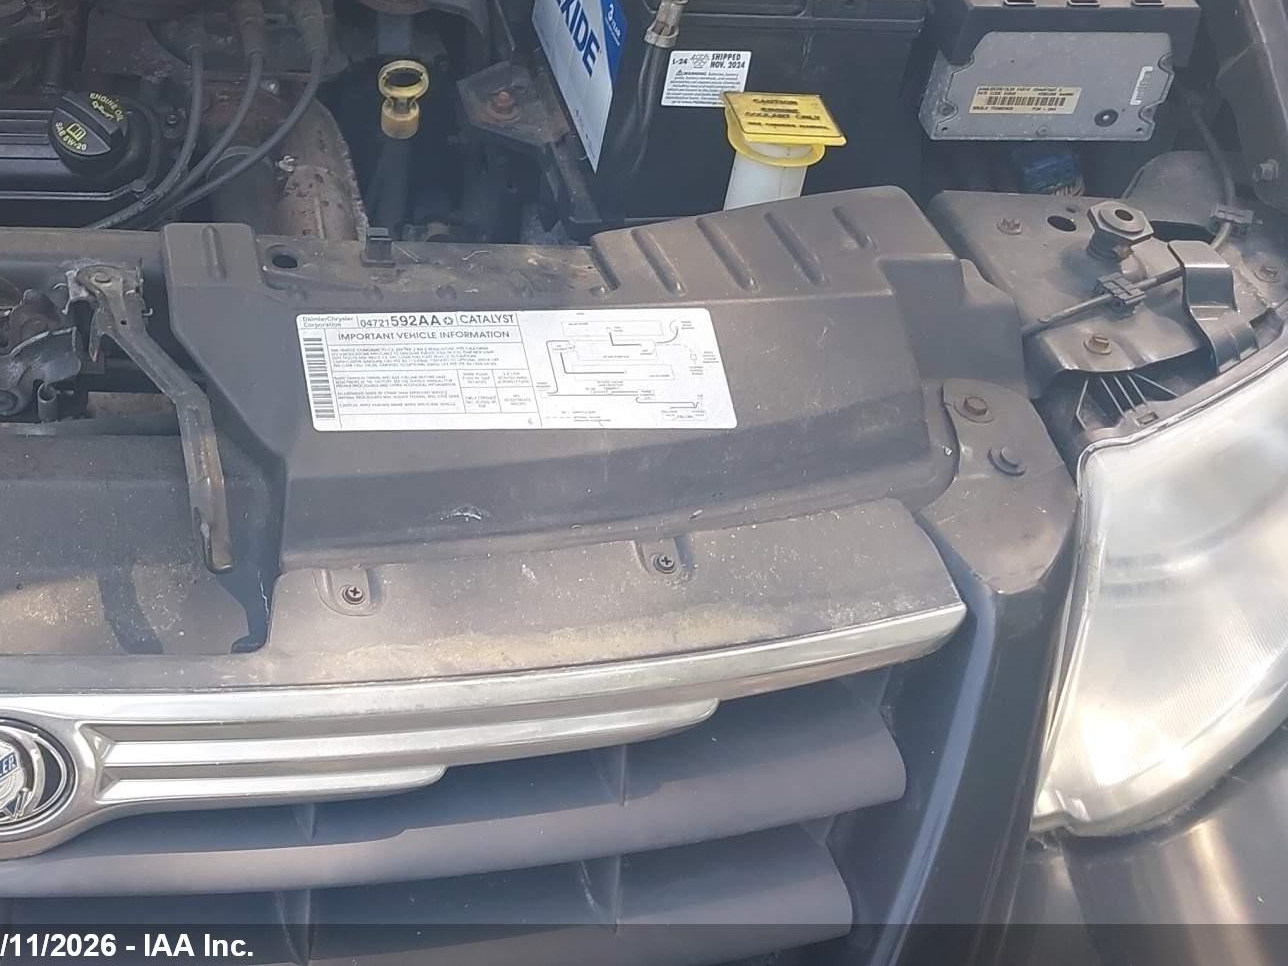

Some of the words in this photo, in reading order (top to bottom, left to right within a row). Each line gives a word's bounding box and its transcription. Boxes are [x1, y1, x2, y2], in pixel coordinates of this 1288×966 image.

[712, 53, 741, 61] SHIPPED
[710, 61, 726, 69] NOV.
[727, 61, 746, 69] 2024
[89, 92, 118, 111] ENGINE
[114, 108, 125, 122] OIL
[302, 316, 354, 324] DaimlerChrysler
[459, 314, 514, 325] CATALYST
[338, 332, 395, 341] IMPORTANT
[398, 332, 436, 340] VEHICLE
[439, 331, 510, 339] INFORMATION
